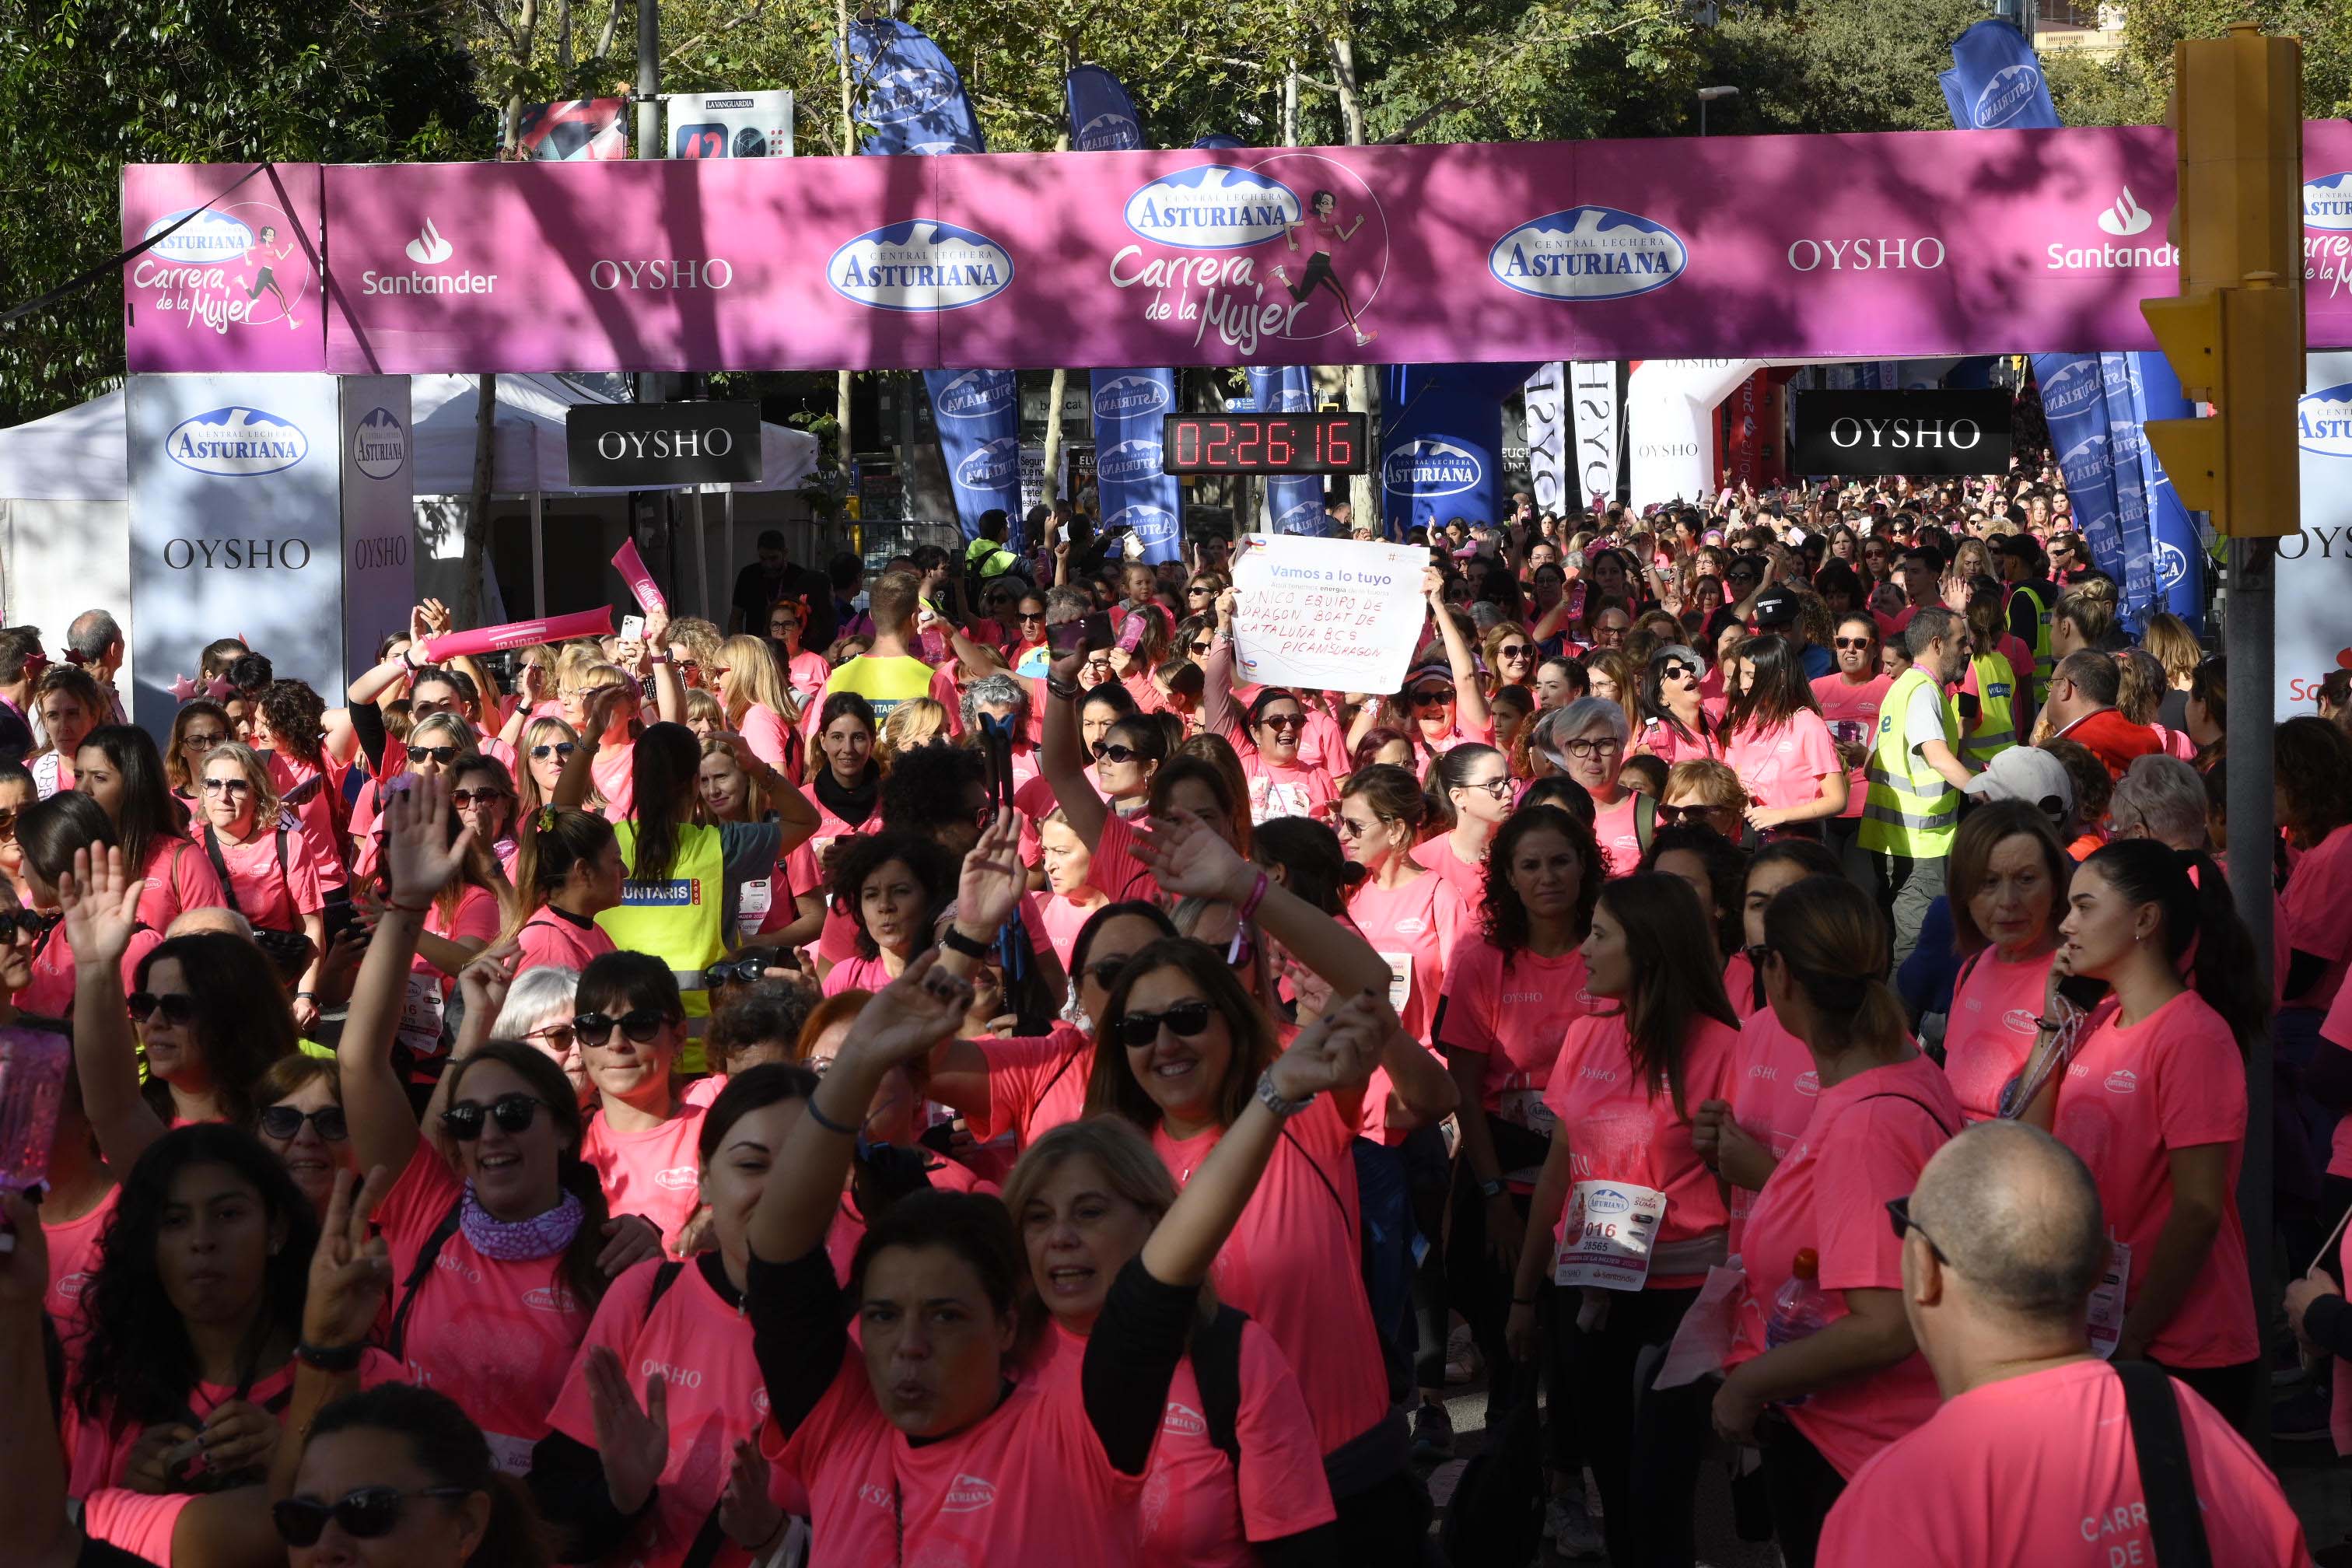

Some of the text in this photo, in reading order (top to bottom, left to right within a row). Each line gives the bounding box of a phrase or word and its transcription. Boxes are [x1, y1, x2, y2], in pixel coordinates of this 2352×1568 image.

[715, 100, 753, 108] VANGUARDIA
[1226, 191, 1283, 202] LECHERA
[1138, 197, 1286, 228] ASTURIANA
[870, 251, 928, 261] CENTRAL
[1535, 237, 1665, 249] CENTRAL LECHERA
[1788, 236, 1945, 271] OYSHO
[2047, 242, 2180, 269] Santande
[841, 254, 999, 287] ASTURIANA
[1109, 245, 1255, 288] Carrera
[1504, 242, 1672, 277] ASTURIANA
[2320, 259, 2333, 280] la
[134, 260, 225, 289] Carrera
[362, 270, 497, 295] Santander
[590, 258, 733, 290] OYSHO
[156, 285, 261, 334] de la Mujer
[1145, 282, 1310, 355] de la Mujer
[177, 432, 298, 459] ASTURIANA
[597, 428, 733, 460] OYSHO
[1830, 417, 1980, 450] OYSHO
[358, 435, 402, 462] ASTURIANA
[1079, 456, 1097, 465] ELV
[1639, 443, 1699, 459] OYSHO
[1387, 461, 1474, 483] ASTURIANA
[163, 538, 311, 569] OYSHO
[355, 535, 407, 570] OYSHO
[1271, 565, 1391, 586] Vamos a lo tuyo
[1246, 591, 1384, 611] UNICO EQUIPO DE
[1242, 605, 1376, 626] DRAGON BOAT DE
[1241, 623, 1315, 639] CATALUÑA
[1503, 992, 1543, 1003] OYSHO
[1633, 1199, 1657, 1209] SUMA
[1585, 1222, 1618, 1238] 016
[1583, 1241, 1608, 1251] 28565
[2081, 1502, 2149, 1542] CARR
[2109, 1540, 2144, 1568] DE
